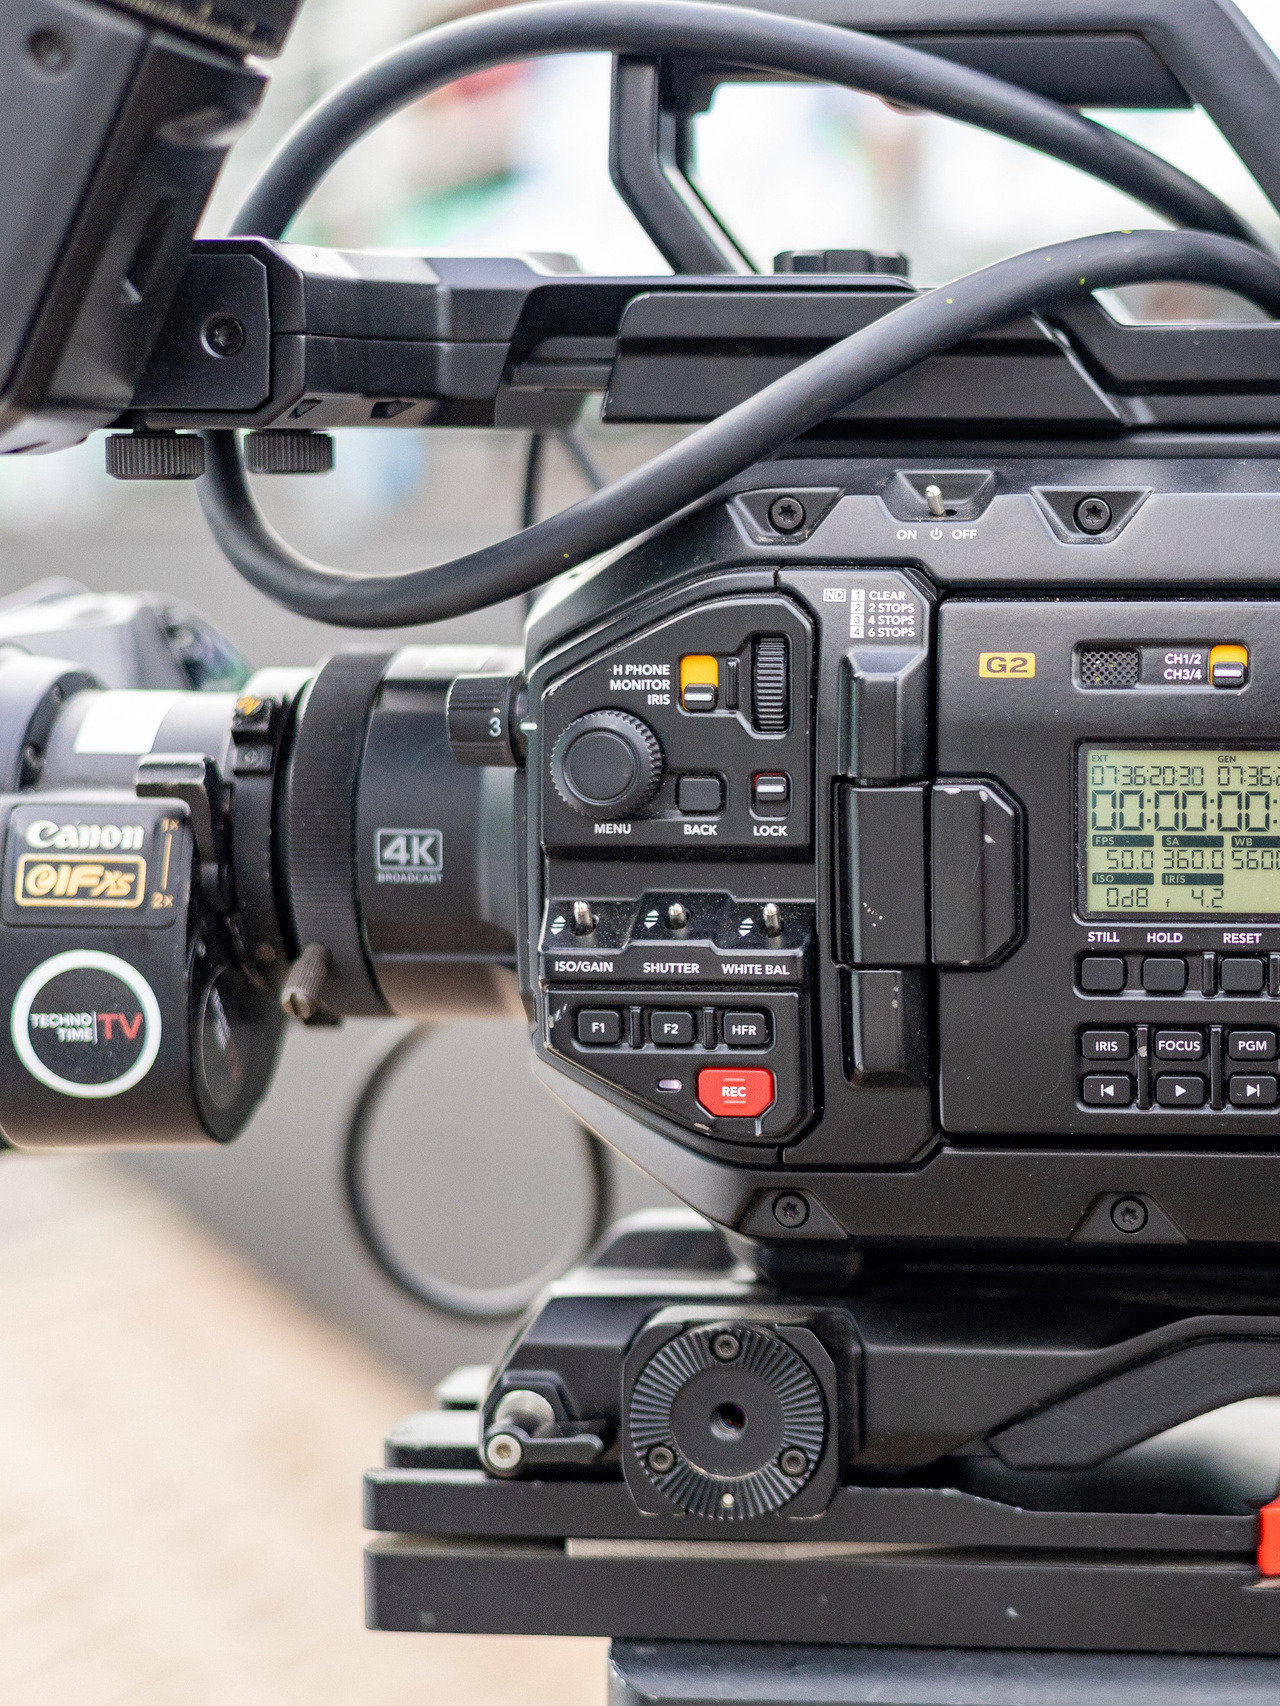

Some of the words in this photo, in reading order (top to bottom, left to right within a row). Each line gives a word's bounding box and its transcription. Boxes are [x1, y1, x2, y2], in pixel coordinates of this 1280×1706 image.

[897, 530, 918, 540] ON
[951, 530, 978, 540] OFF
[827, 591, 844, 599] ND
[869, 591, 906, 601] CLEAR
[868, 603, 876, 613] 2
[878, 603, 915, 613] STOPS
[868, 615, 876, 625] 4
[878, 615, 915, 625] STOPS
[868, 628, 876, 637] 6
[878, 628, 916, 638] STOPS
[1164, 653, 1202, 665] CH1/2
[613, 665, 623, 675] H
[625, 664, 670, 676] PHONE
[986, 656, 1028, 674] G2
[1163, 669, 1202, 680] CH3/4
[610, 679, 670, 690] MONITOR
[648, 694, 670, 705] IRIS
[489, 717, 502, 737] 3
[1217, 755, 1236, 763] GEN
[594, 824, 631, 834] MENU
[684, 825, 718, 835] BACK
[753, 825, 787, 836] LOCK
[25, 820, 144, 850] Canon
[1095, 836, 1115, 845] FPS
[1166, 837, 1179, 846] SA
[1235, 837, 1253, 846] WB
[383, 835, 437, 866] 4K
[1106, 849, 1154, 870] 50.0
[1163, 849, 1224, 870] 360.0
[378, 873, 443, 882] BROADCAST
[1095, 874, 1115, 883] ISO
[1165, 875, 1186, 884] IRIS
[1191, 888, 1224, 908] 4.2
[1087, 932, 1120, 943] STILL
[1146, 932, 1183, 943] HOLD
[1223, 933, 1262, 944] RESET
[555, 960, 613, 972] ISO/GAIN
[643, 962, 699, 974] SHUTTER
[722, 963, 763, 975] WHITE
[765, 964, 790, 975] BAL
[31, 1013, 92, 1028] TECHNO
[98, 1013, 143, 1040] TV
[592, 1022, 605, 1033] F1
[664, 1024, 679, 1034] F2
[732, 1025, 757, 1036] HFR
[57, 1027, 93, 1042] TIME
[1095, 1041, 1118, 1052] IRIS
[1158, 1040, 1200, 1051] FOCUS
[1238, 1040, 1267, 1052] PGM
[722, 1087, 746, 1098] REC
